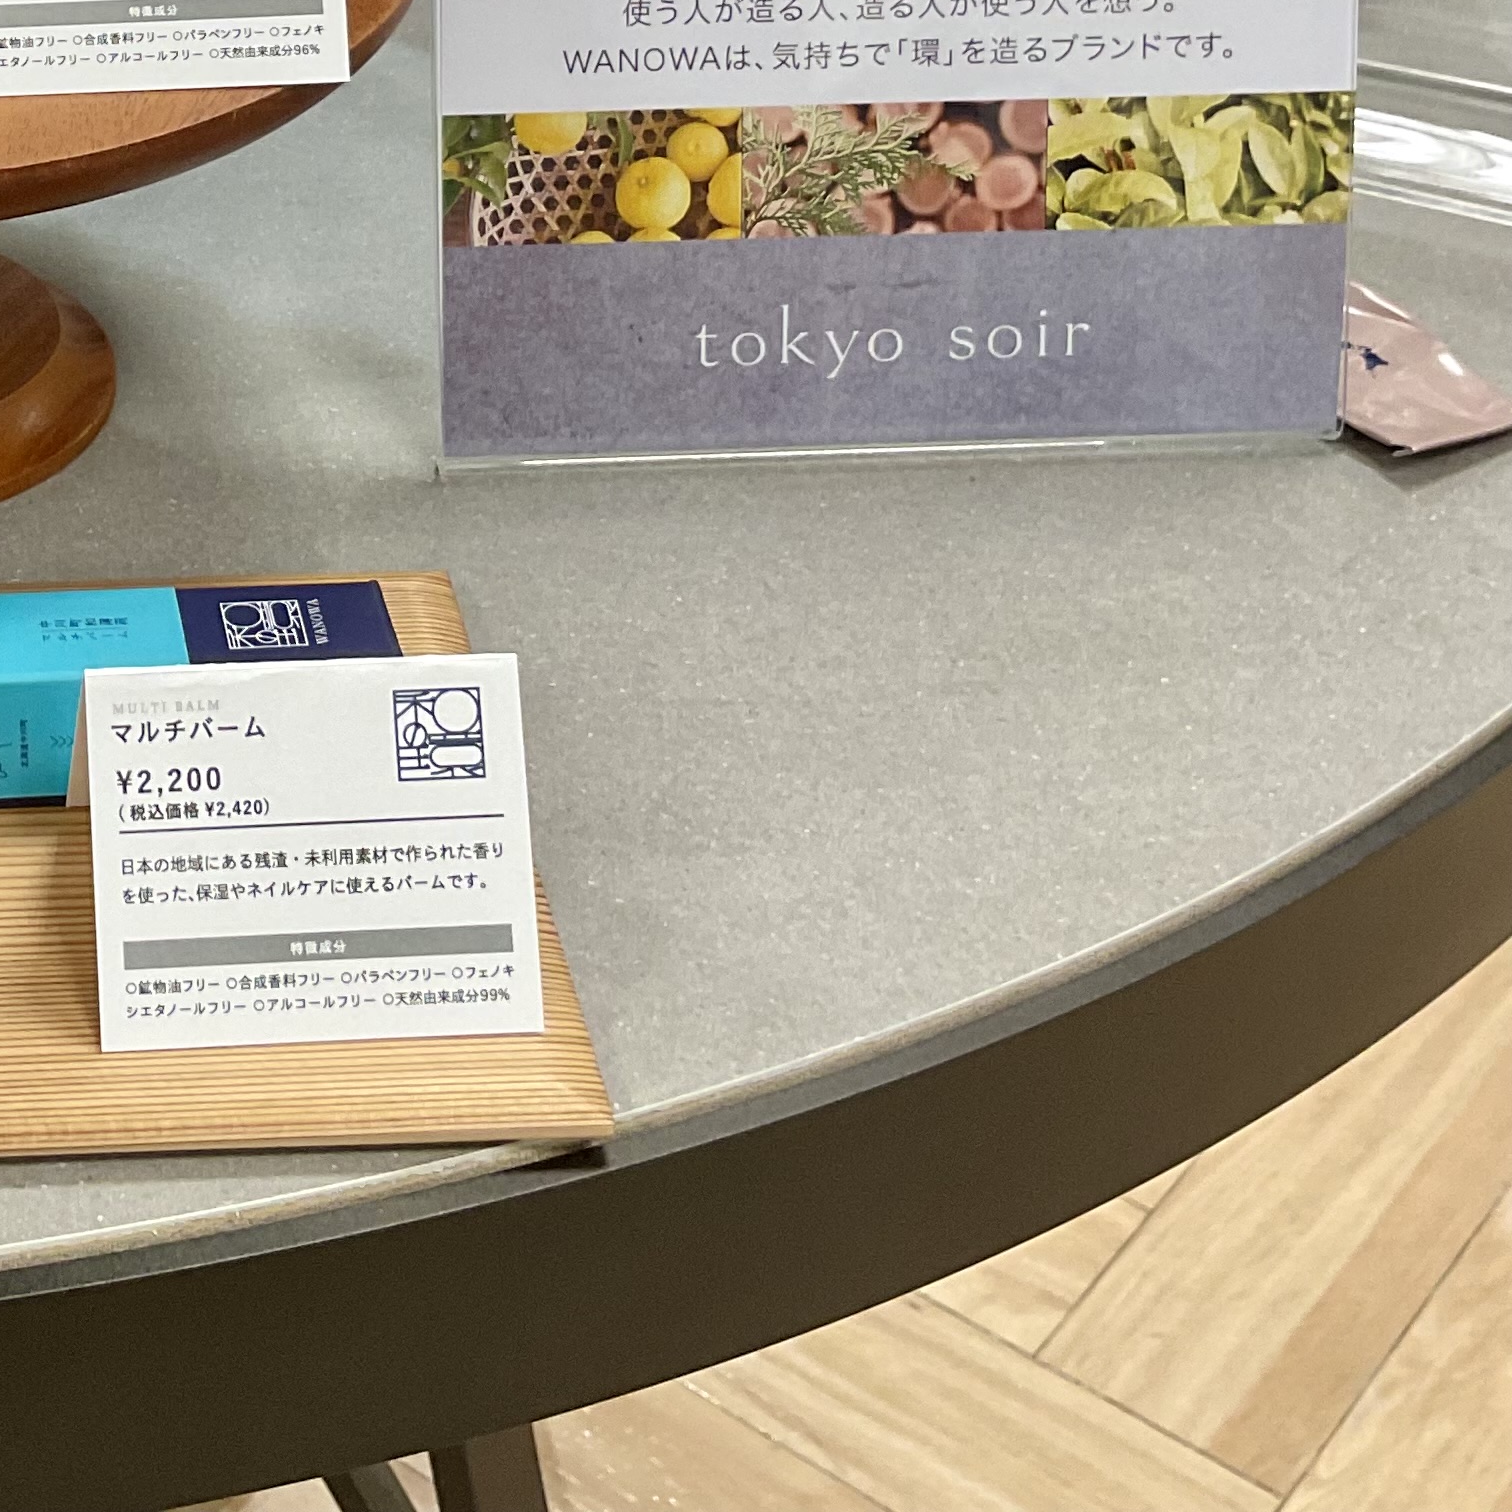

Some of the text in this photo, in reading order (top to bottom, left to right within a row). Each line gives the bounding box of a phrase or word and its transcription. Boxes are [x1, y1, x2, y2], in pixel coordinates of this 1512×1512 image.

[562, 28, 1238, 76] WANOWAは、気持ちで「環」を造るブランドです。
[695, 305, 1095, 380] tokyo soir
[306, 598, 329, 645] WANOWA
[112, 698, 221, 716] MULTI BALM
[110, 716, 267, 744] マルチバーム
[115, 766, 223, 798] ¥2,200
[121, 873, 489, 905] を使った、保湿やネイルケアに使えるバームです。
